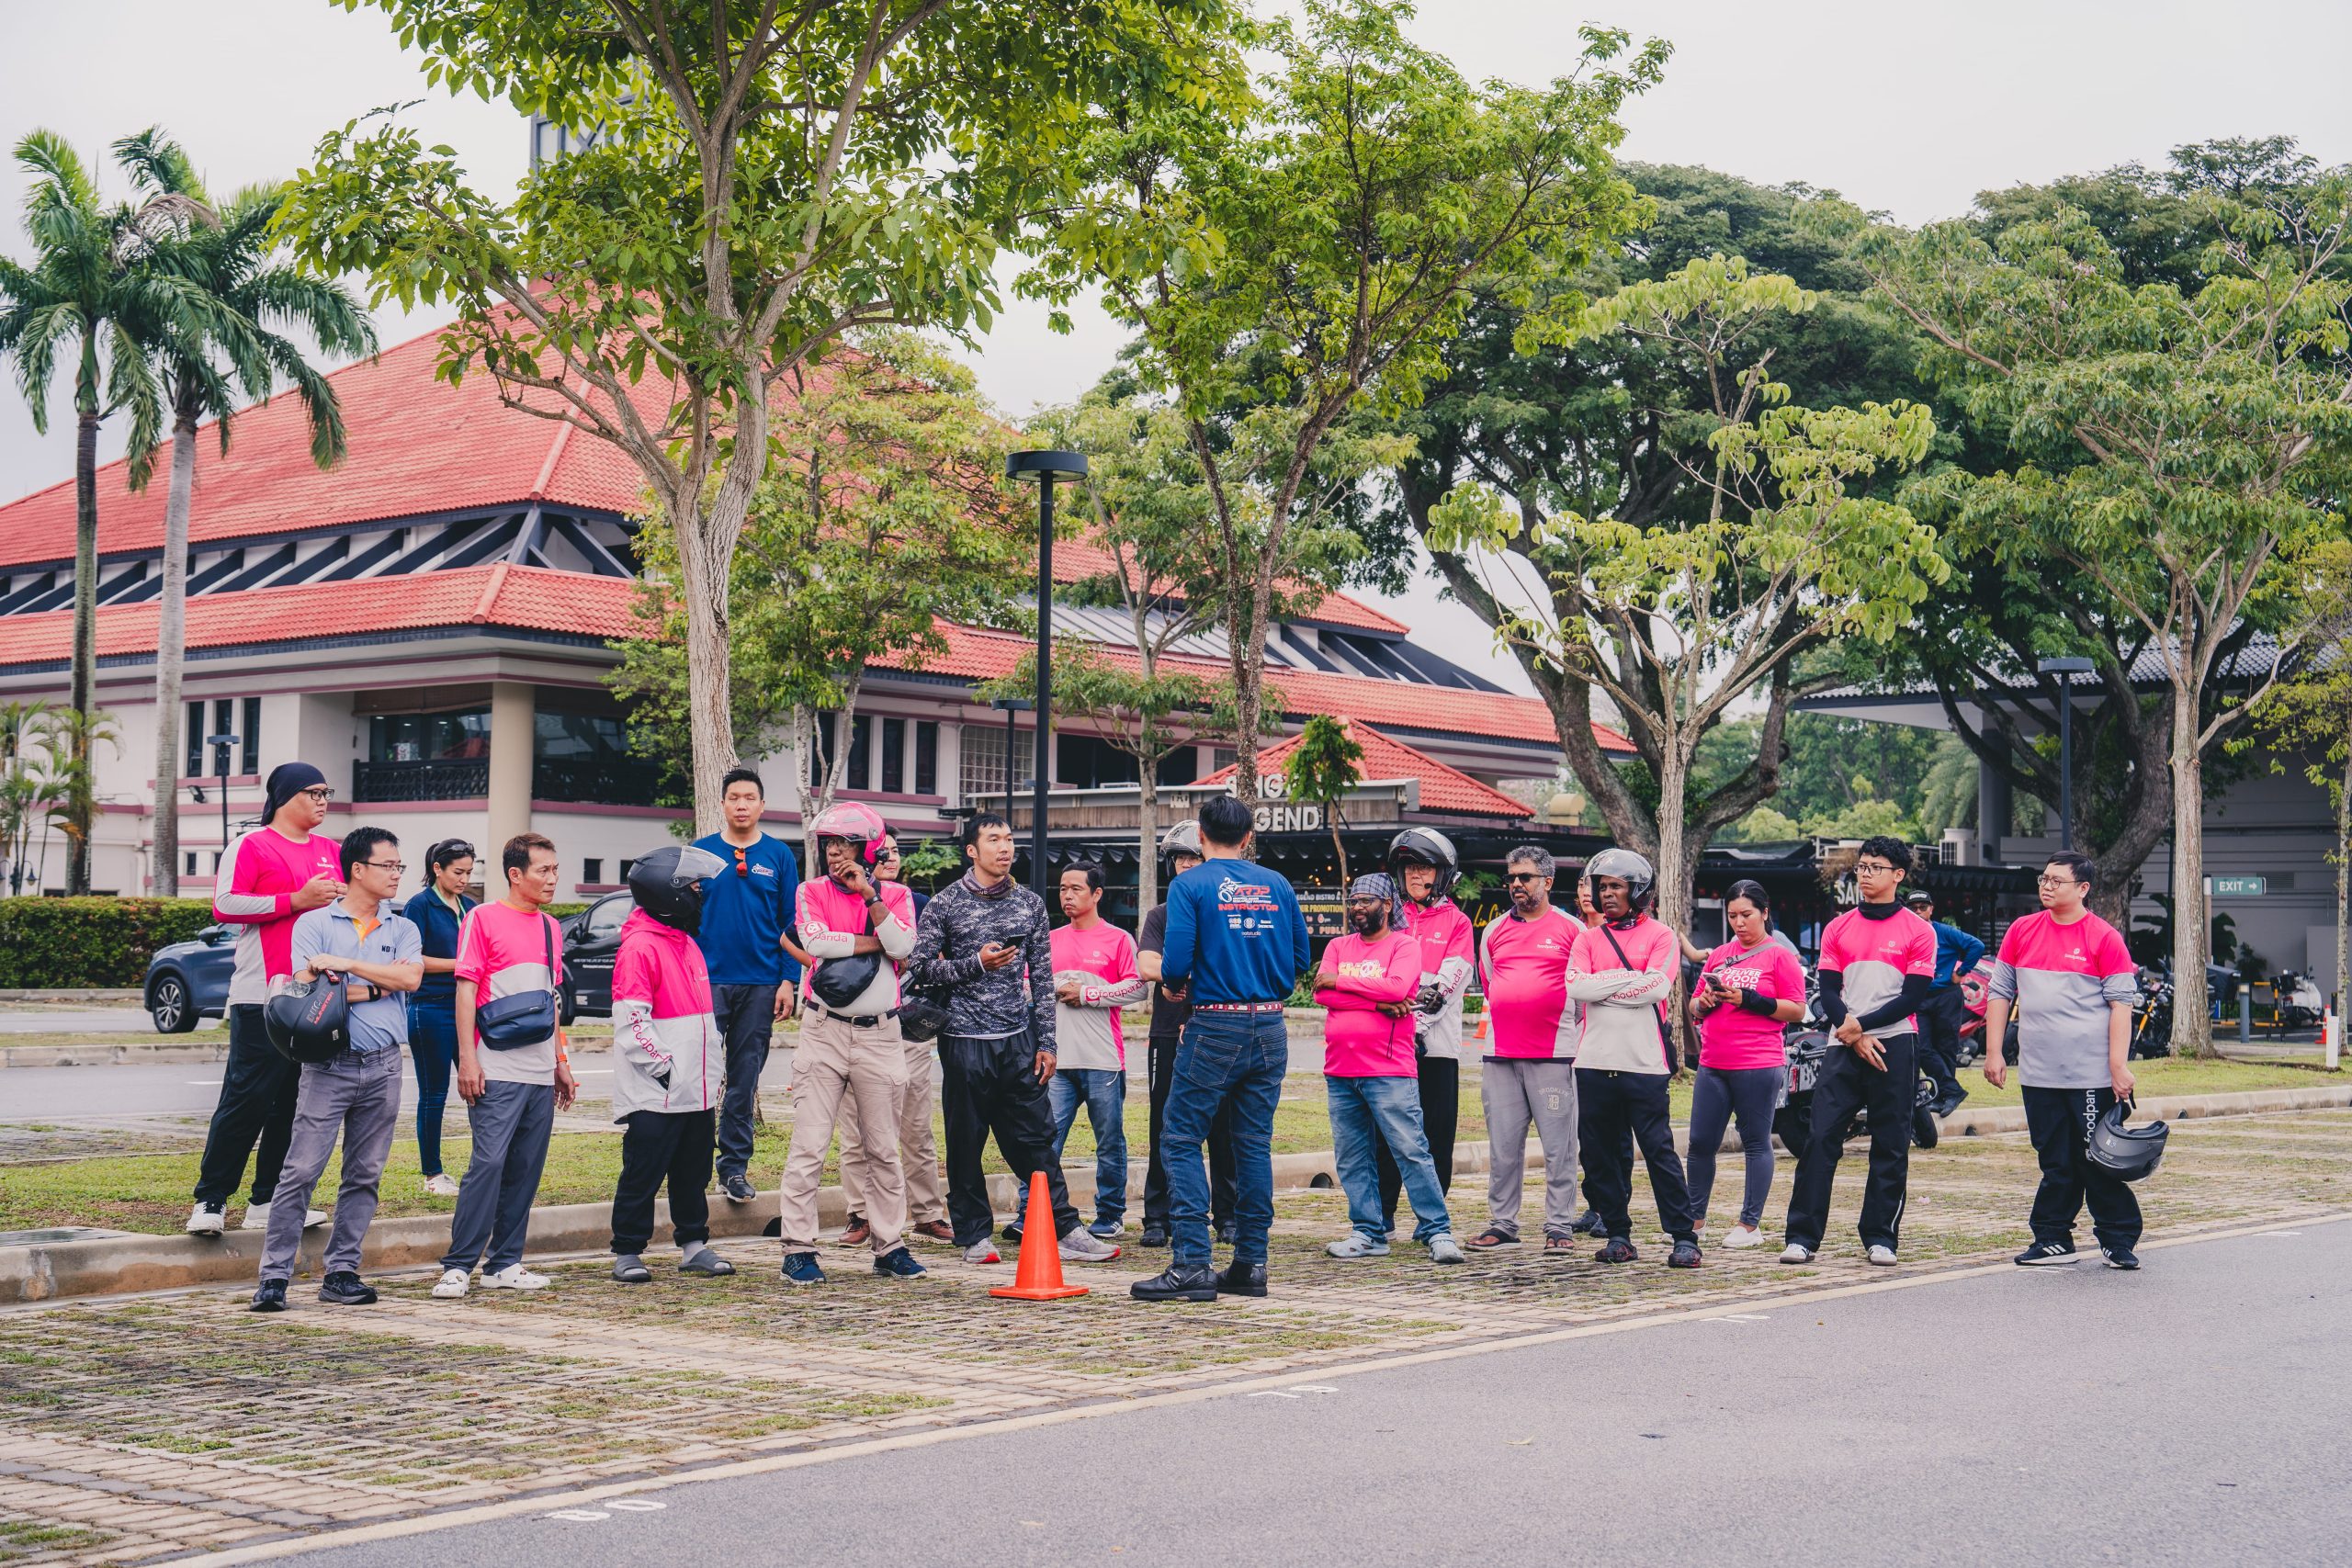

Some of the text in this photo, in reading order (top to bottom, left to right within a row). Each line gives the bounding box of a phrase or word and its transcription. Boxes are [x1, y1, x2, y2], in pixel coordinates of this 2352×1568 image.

[1254, 807, 1320, 832] GEND
[2219, 881, 2244, 892] EXIT
[1295, 893, 1315, 901] EGEND
[1218, 903, 1279, 911] INSTRUCTOR
[1724, 966, 1762, 978] DELIVER
[1725, 975, 1759, 984] FOOD
[1442, 968, 1463, 998] panda
[1612, 976, 1665, 999] oodpanda
[632, 1024, 673, 1066] oodpand
[2083, 1089, 2099, 1143] foodpan
